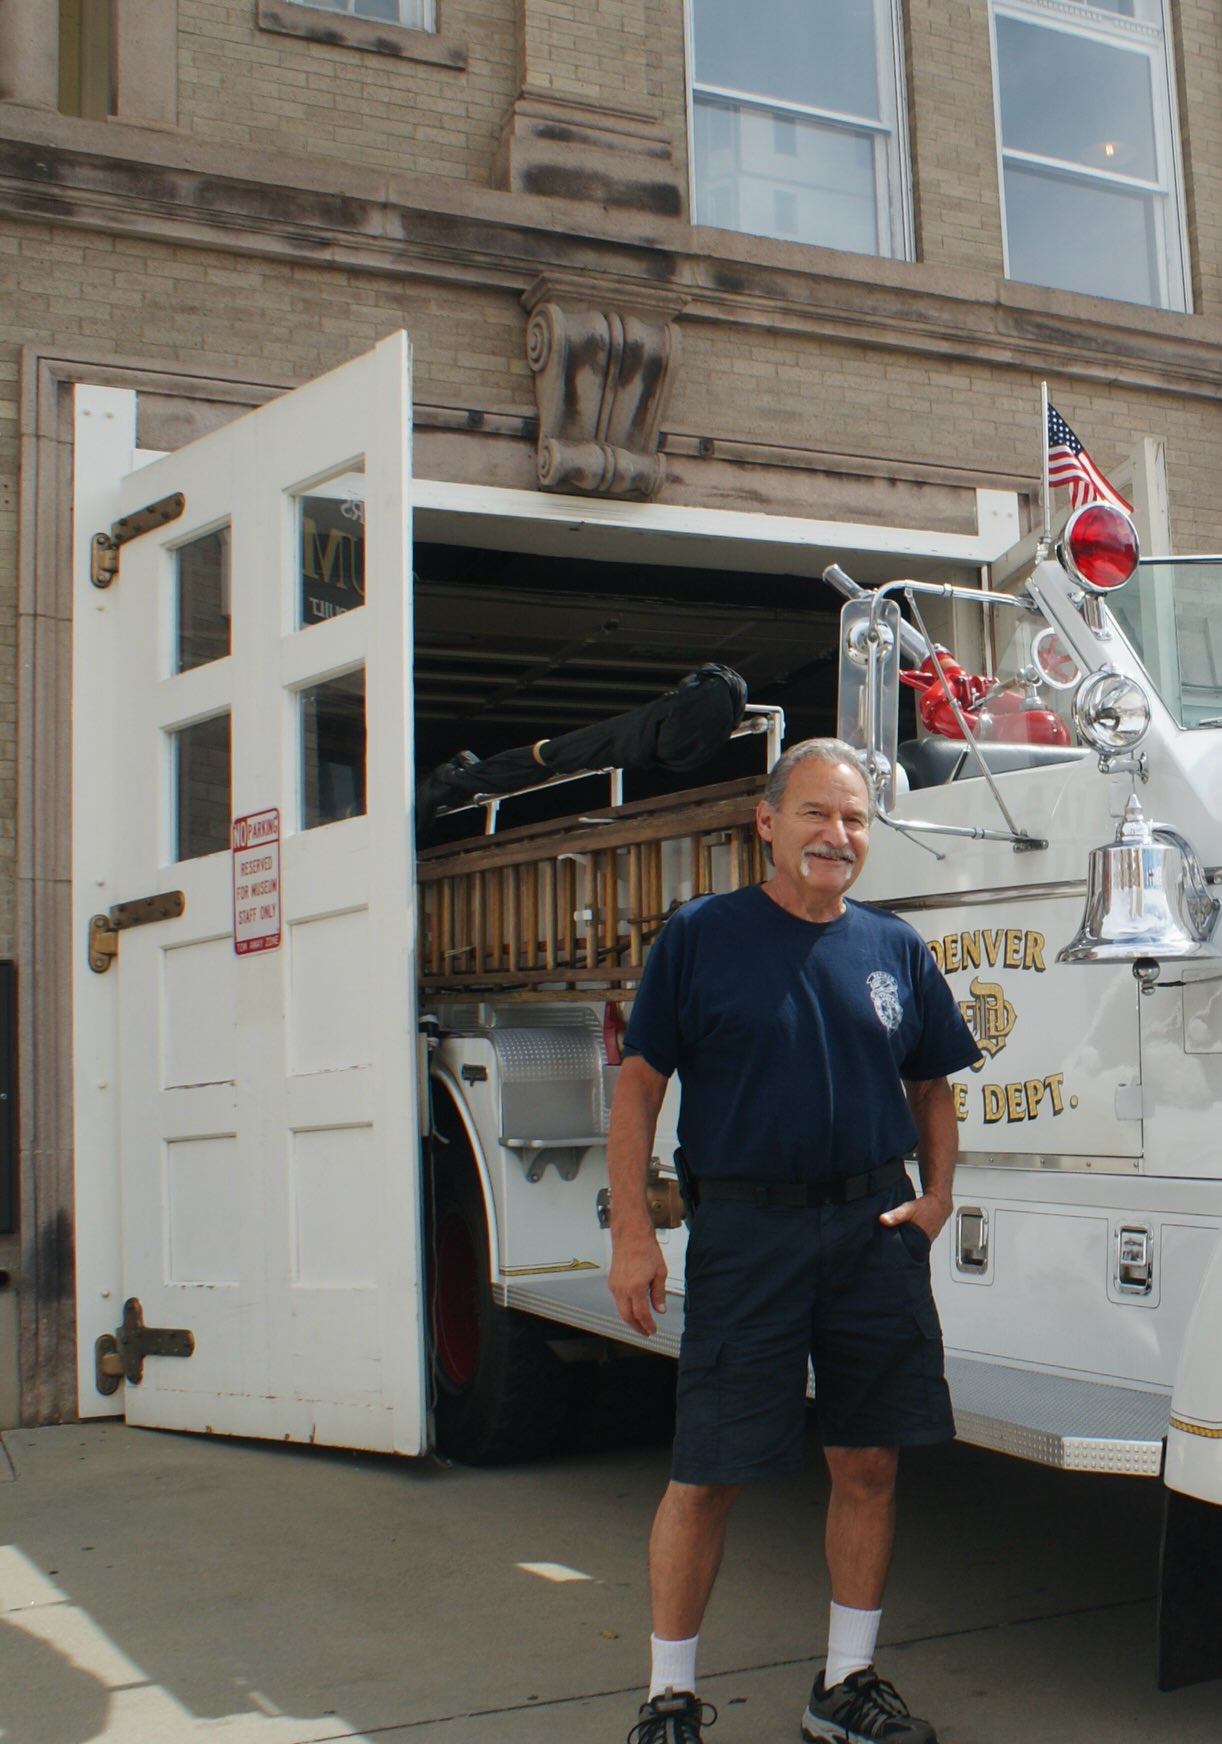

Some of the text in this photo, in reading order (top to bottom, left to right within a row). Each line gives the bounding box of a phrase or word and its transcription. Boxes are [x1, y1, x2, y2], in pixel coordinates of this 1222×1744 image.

[232, 815, 279, 849] NO PARKING
[241, 856, 272, 876] RESERVED
[237, 879, 277, 899] FOR MUSEUM
[239, 904, 275, 924] STAFF ONLY
[926, 929, 1046, 975] DENVER
[983, 1072, 1079, 1124] DEPT.
